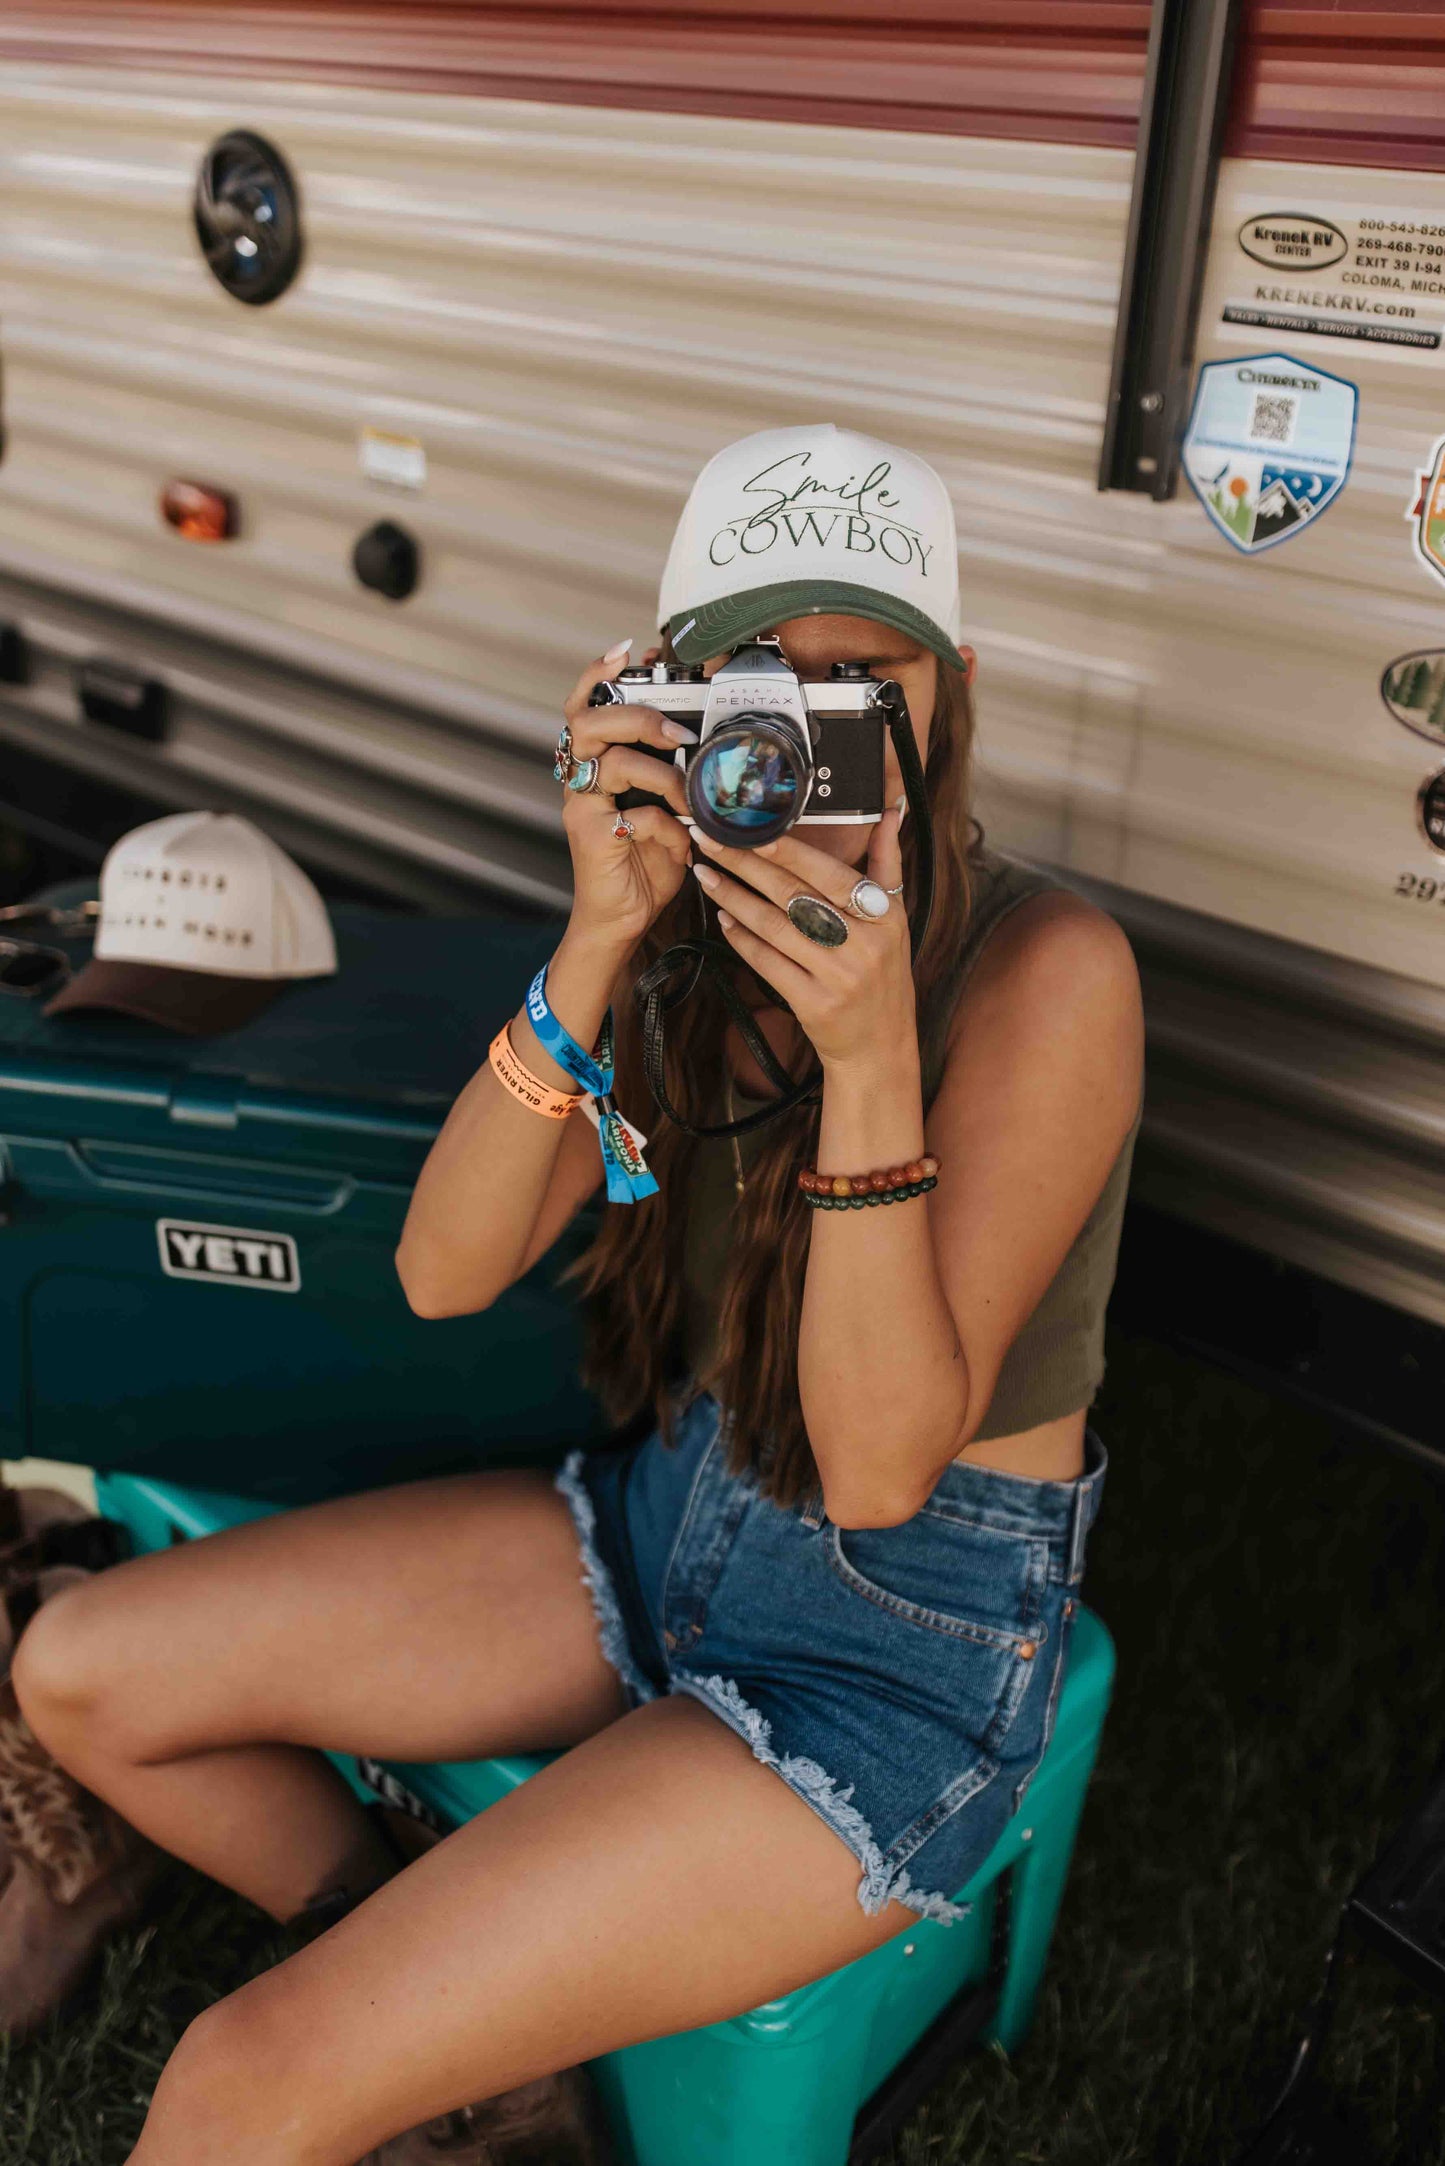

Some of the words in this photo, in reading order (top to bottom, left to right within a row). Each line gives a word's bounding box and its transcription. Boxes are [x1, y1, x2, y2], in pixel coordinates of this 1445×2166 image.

[1274, 243, 1312, 258] CENTER
[1313, 228, 1335, 247] RV
[1357, 236, 1445, 256] 269-468-790
[1355, 255, 1389, 269] EXIT
[1393, 258, 1411, 271] 39
[1415, 261, 1442, 275] I-94
[1341, 270, 1406, 291] COLOMA,
[1254, 285, 1417, 319] KRENEKRV.com
[1229, 309, 1260, 323] SALES
[1266, 314, 1310, 330] RENTALS
[1316, 322, 1360, 336] SERVICE
[1366, 328, 1437, 347] ACCESSORIES
[742, 451, 899, 529] Smile
[709, 511, 934, 577] COWBOY
[637, 697, 693, 705] SPOTMATIC
[716, 697, 793, 705] PENTAX
[495, 1058, 520, 1087] RIVER
[517, 1083, 541, 1106] GILA
[609, 1119, 637, 1173] ARIZONA
[168, 1229, 287, 1280] YETI
